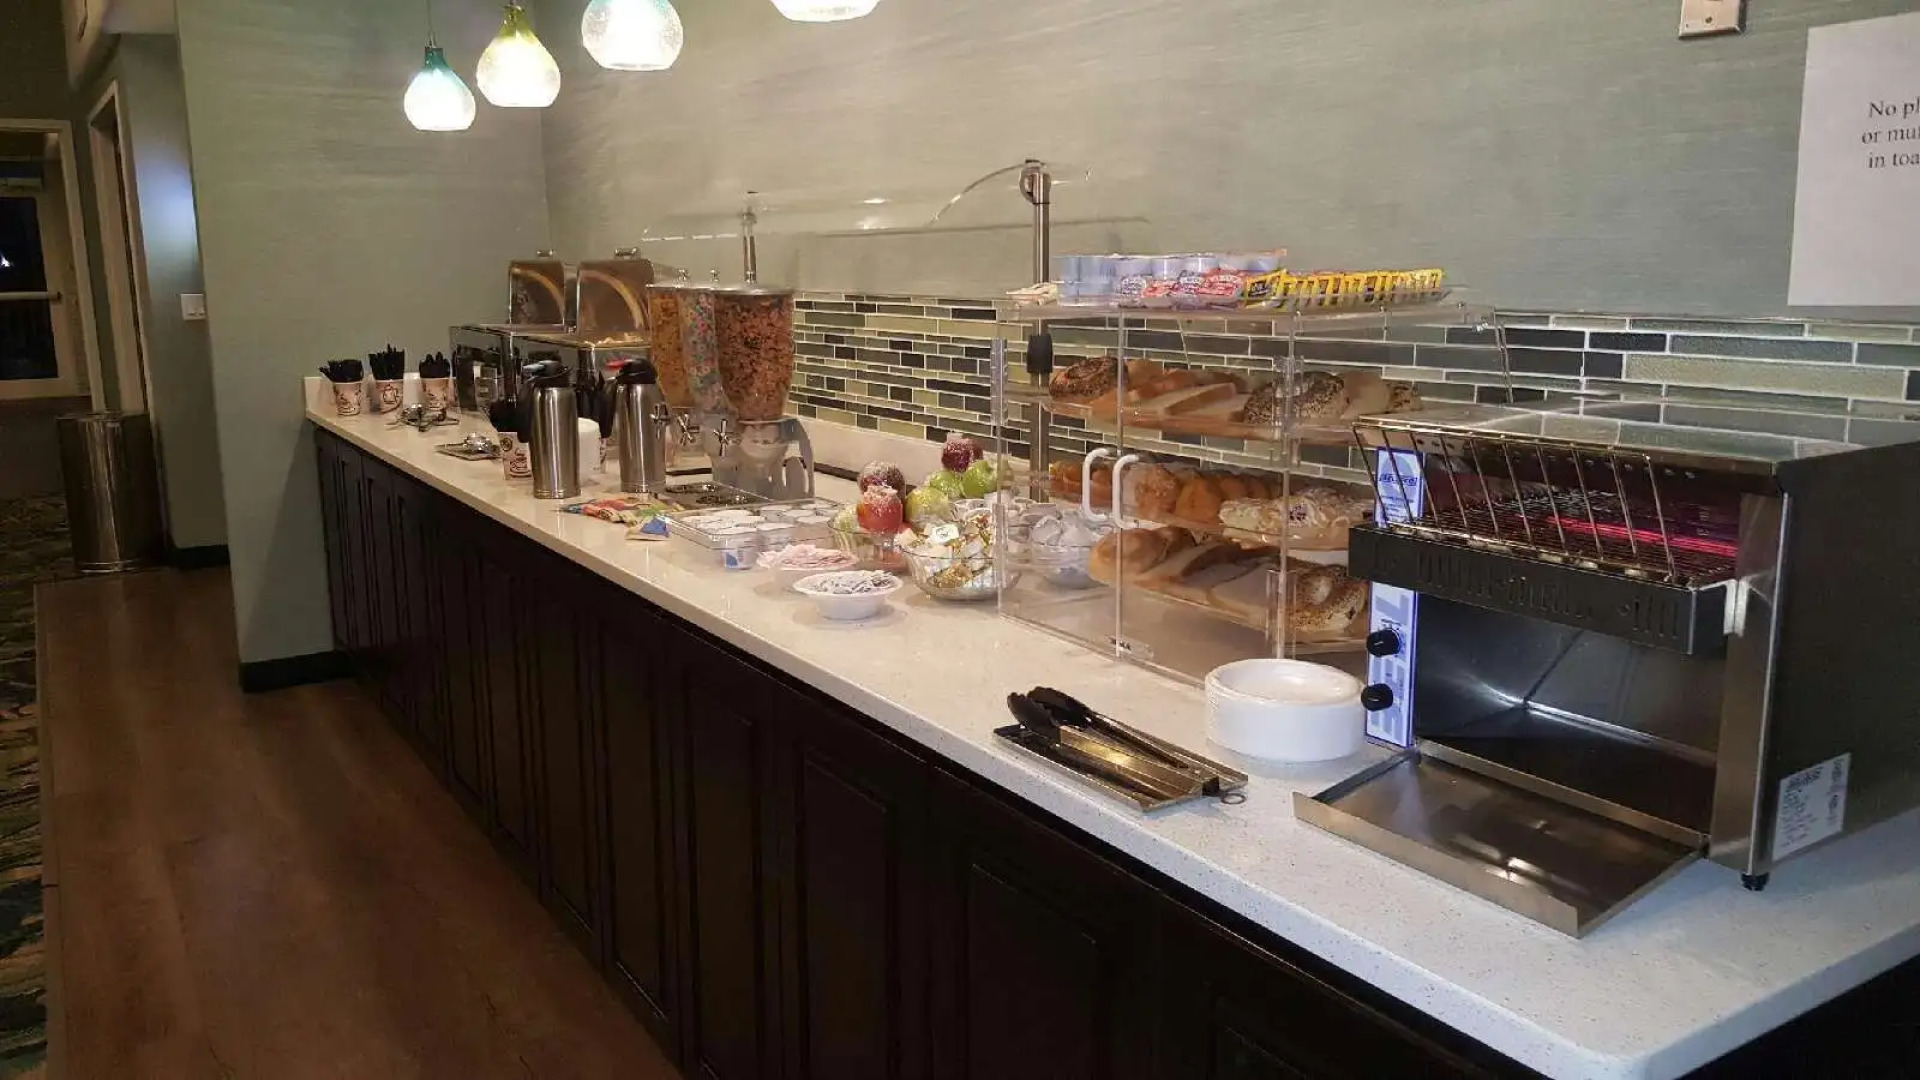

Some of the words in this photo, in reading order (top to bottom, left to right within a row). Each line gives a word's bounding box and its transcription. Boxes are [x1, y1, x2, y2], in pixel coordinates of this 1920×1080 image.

[1869, 100, 1897, 118] No
[1861, 130, 1881, 145] or
[1888, 126, 1920, 142] mu
[1868, 151, 1885, 168] in
